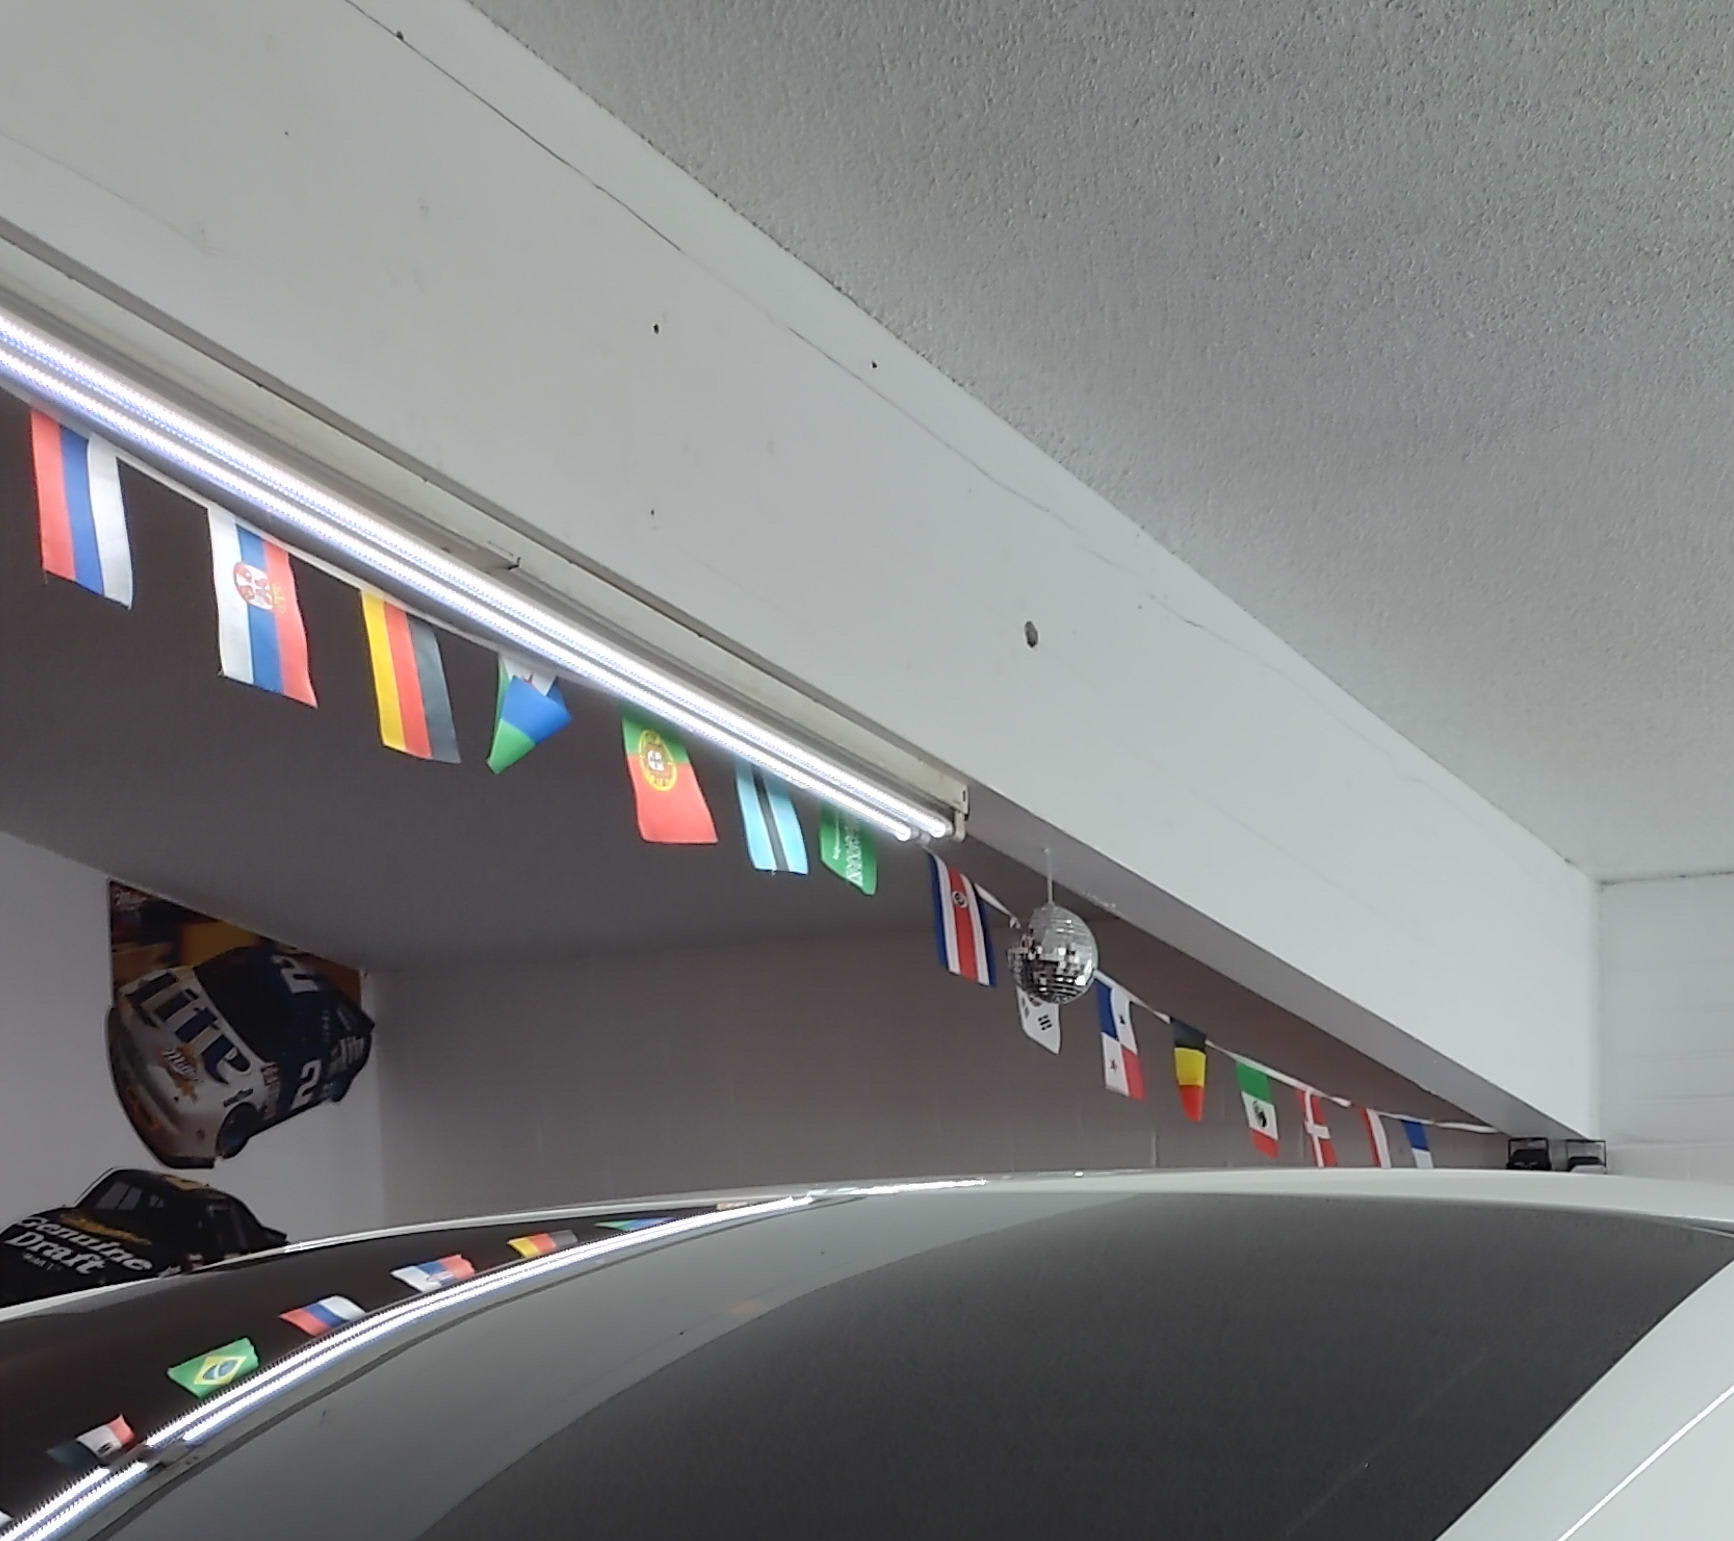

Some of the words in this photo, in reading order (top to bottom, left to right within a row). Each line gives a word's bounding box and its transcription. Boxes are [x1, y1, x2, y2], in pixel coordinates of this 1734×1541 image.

[125, 971, 252, 1085] Lite
[289, 1059, 323, 1111] 2
[4, 1231, 106, 1276] Draft
[16, 1215, 154, 1272] Genuine
